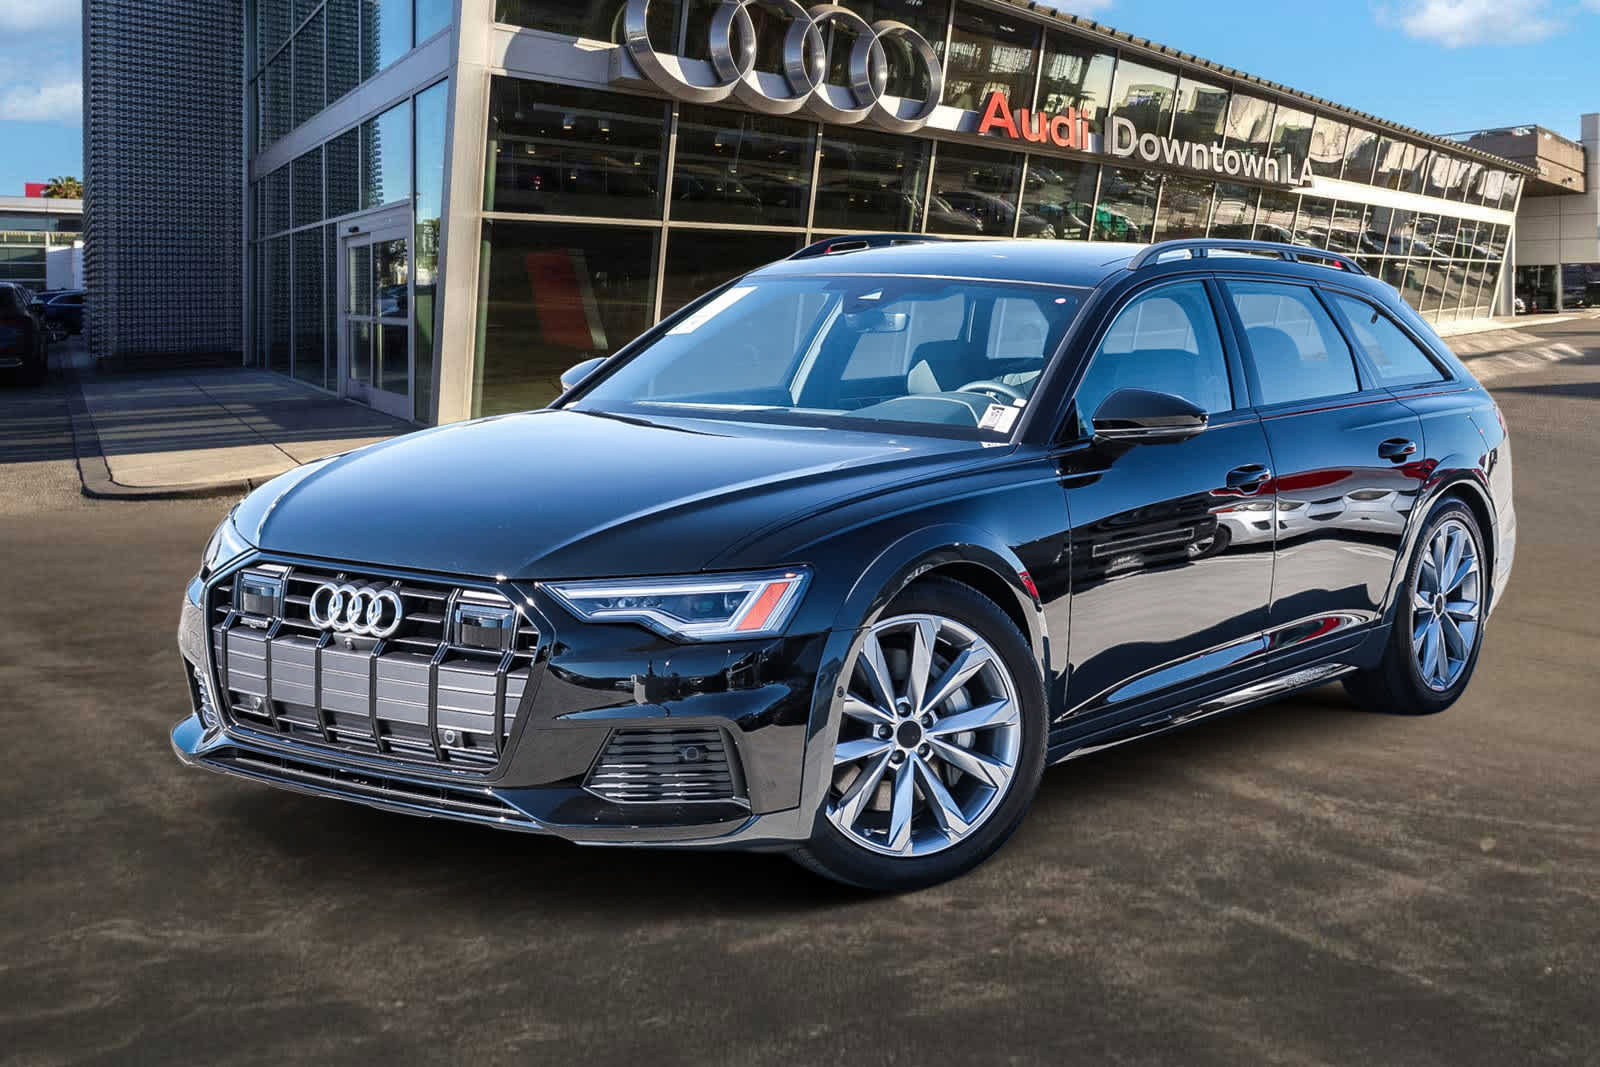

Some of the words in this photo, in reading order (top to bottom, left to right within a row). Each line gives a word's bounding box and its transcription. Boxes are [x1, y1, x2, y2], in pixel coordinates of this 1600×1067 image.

[977, 90, 1089, 151] Audi
[1109, 115, 1279, 182] Downtown
[1286, 153, 1313, 187] LA
